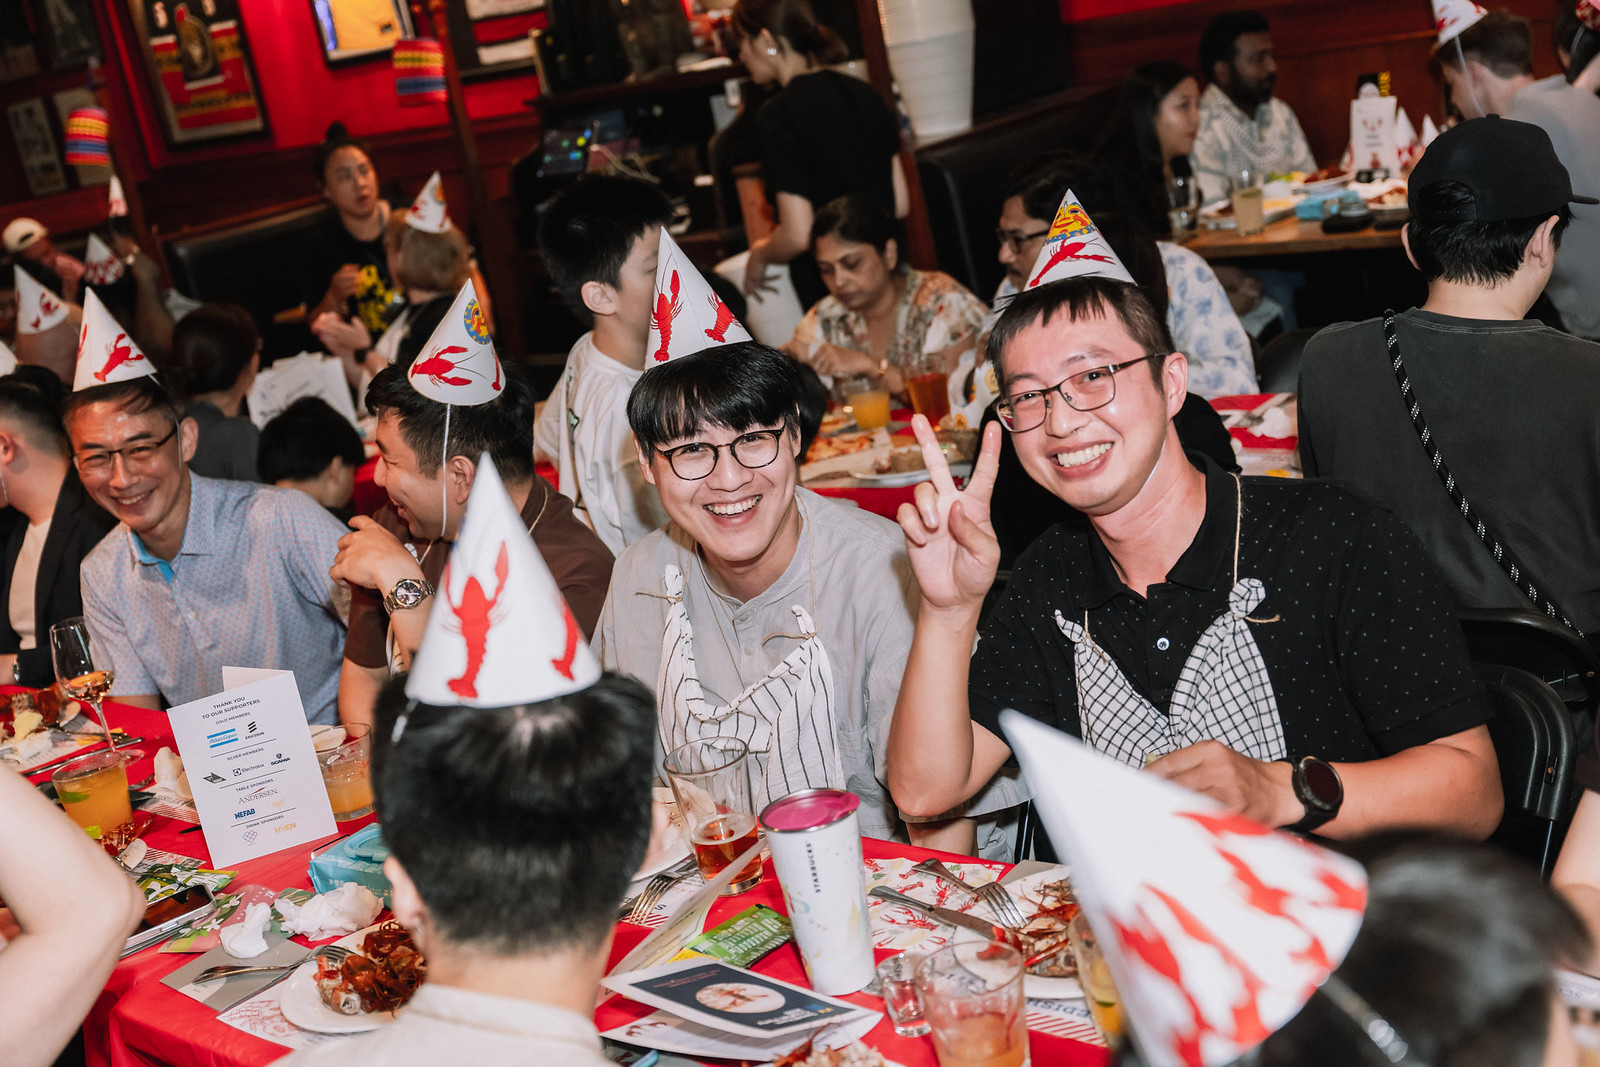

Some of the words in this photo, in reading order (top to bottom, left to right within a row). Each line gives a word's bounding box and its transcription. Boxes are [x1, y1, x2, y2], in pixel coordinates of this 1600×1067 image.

[210, 709, 223, 717] OUR
[224, 699, 261, 713] SUPPORTERS
[229, 712, 250, 721] MEMBERS
[242, 748, 264, 756] MEMBERS
[270, 757, 290, 766] SCANIA
[241, 763, 264, 772] Electrolux
[250, 779, 273, 788] SPONSORS
[238, 788, 278, 805] ANDERSEN
[234, 808, 256, 820] NEFAB
[260, 815, 284, 824] SPONSORS
[806, 843, 821, 893] STARBUCKS
